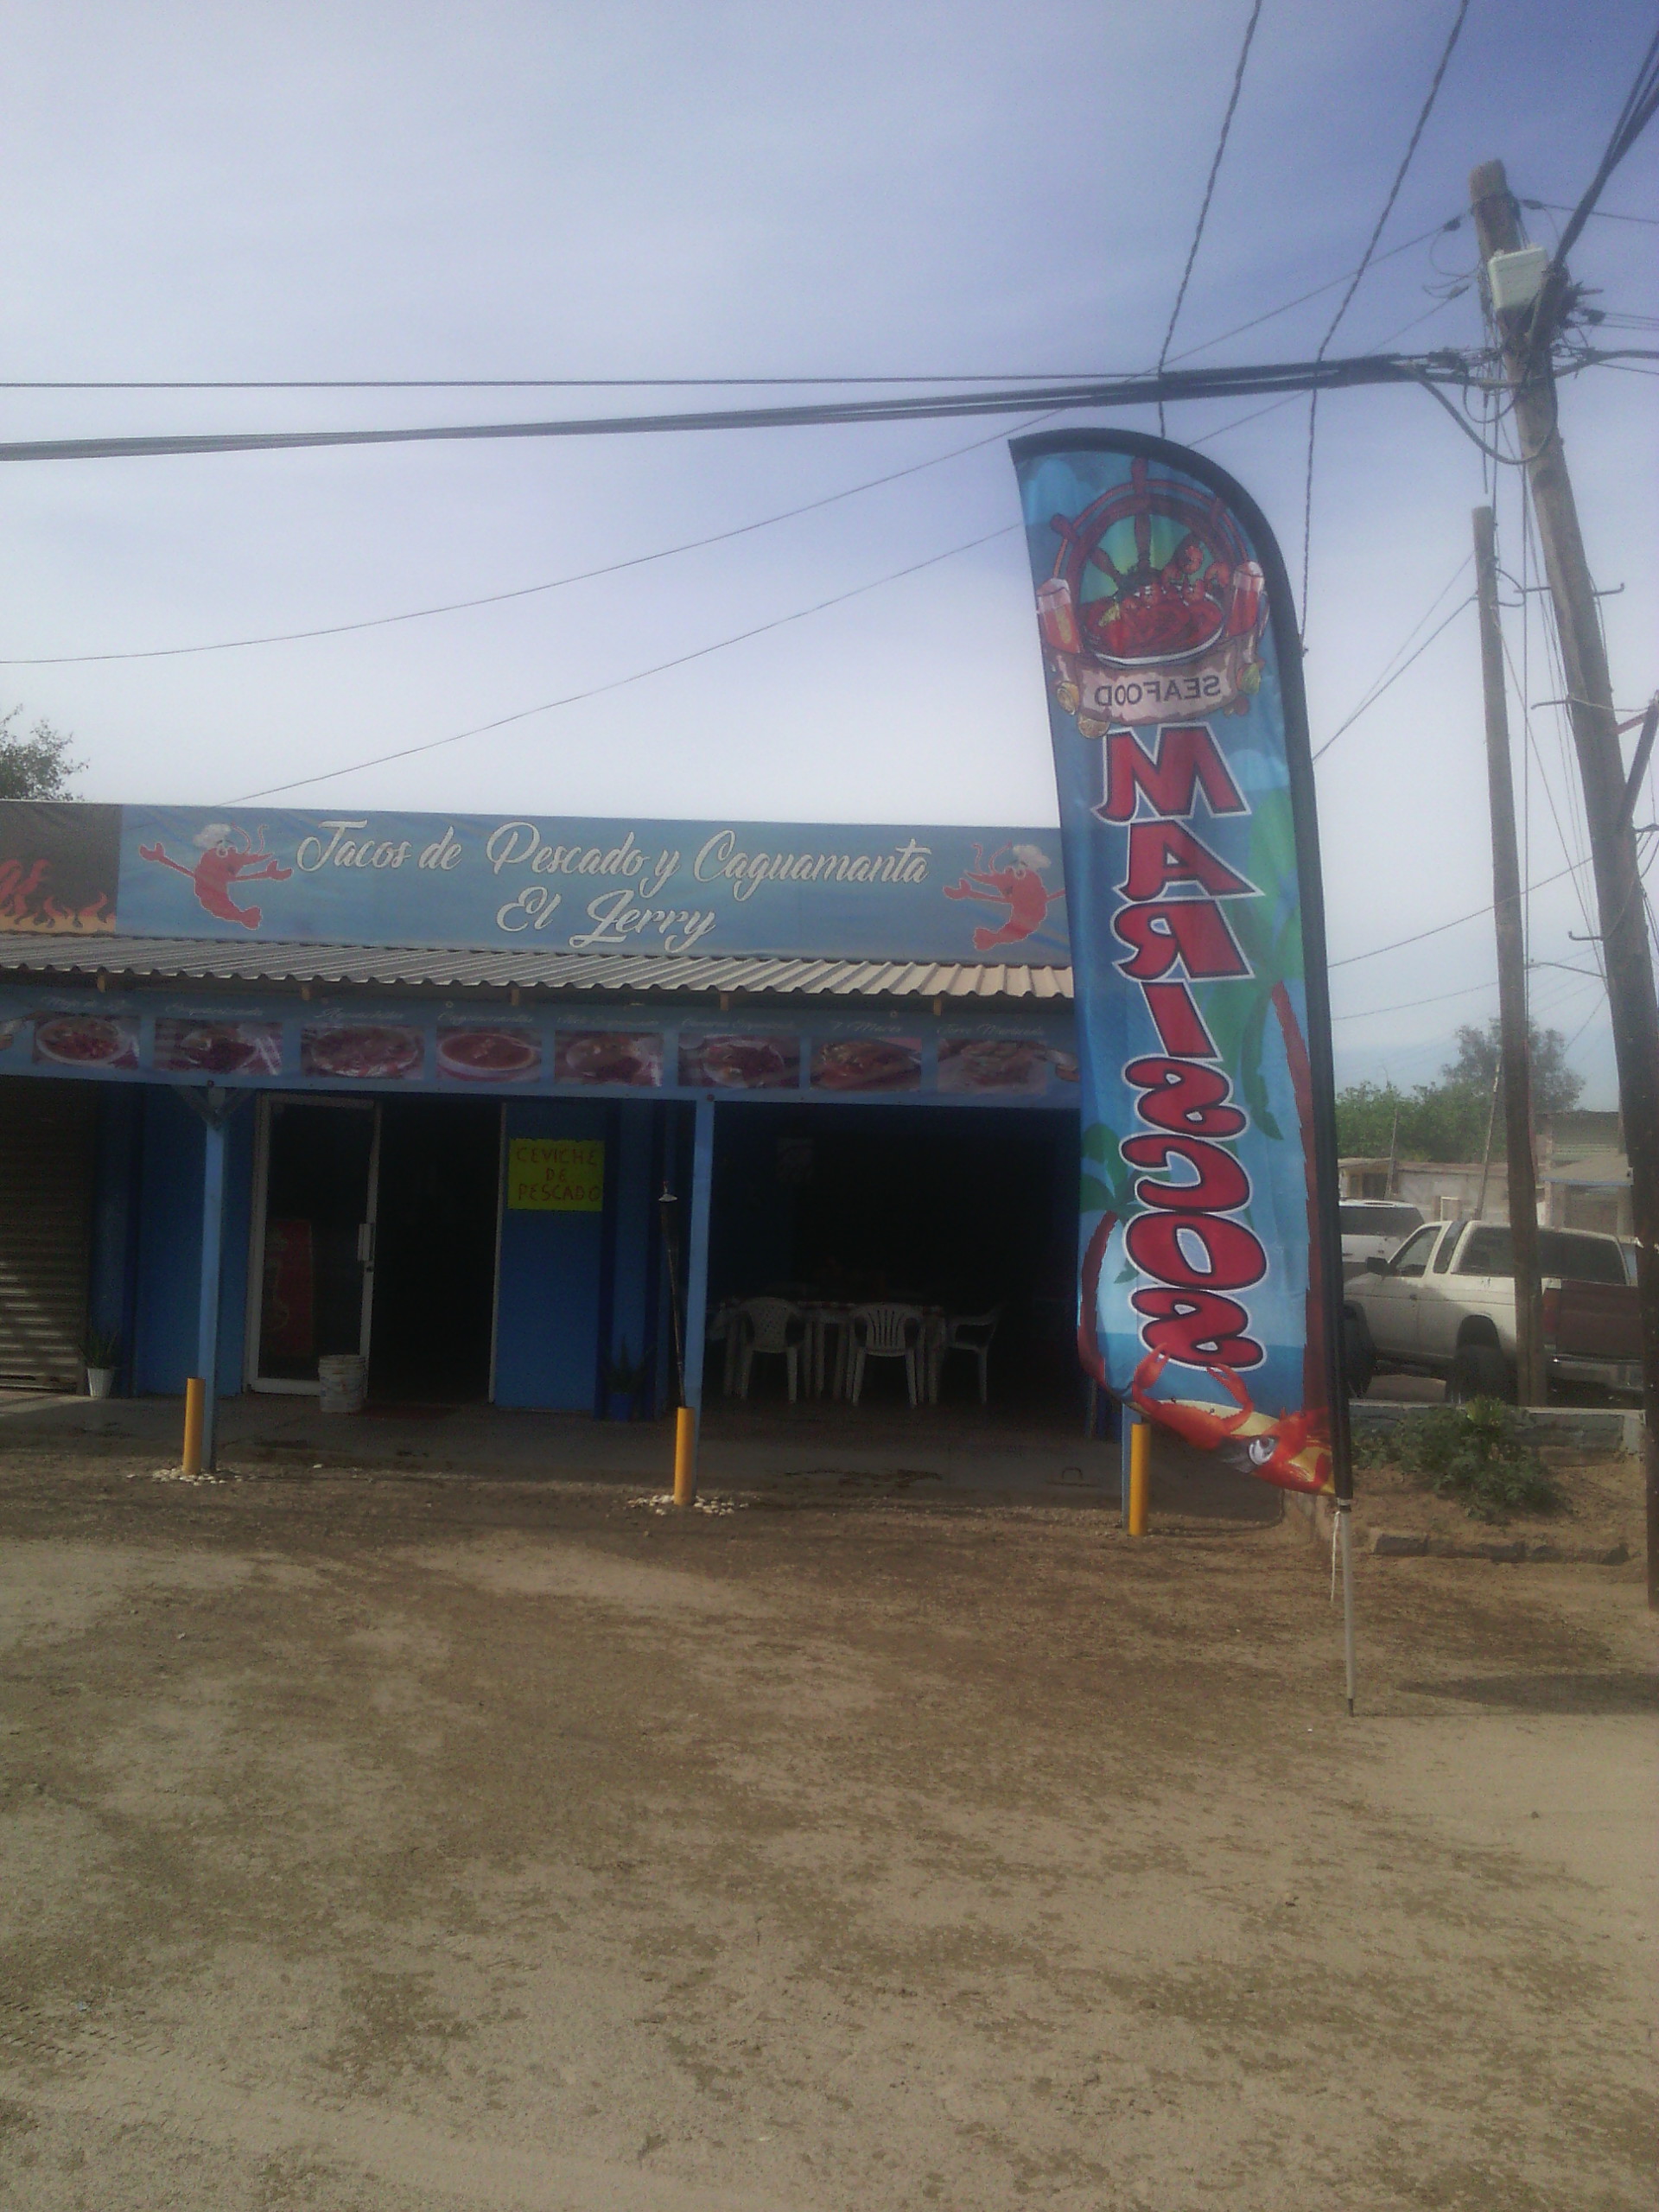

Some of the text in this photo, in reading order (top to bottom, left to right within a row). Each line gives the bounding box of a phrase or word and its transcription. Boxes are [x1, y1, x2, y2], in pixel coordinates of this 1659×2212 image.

[296, 819, 932, 902] Tacos de Pescado y Caguamanta
[496, 886, 562, 932] El
[516, 1146, 598, 1168] CEVICHE
[545, 1167, 567, 1183] DE
[518, 1182, 601, 1202] PESCADO
